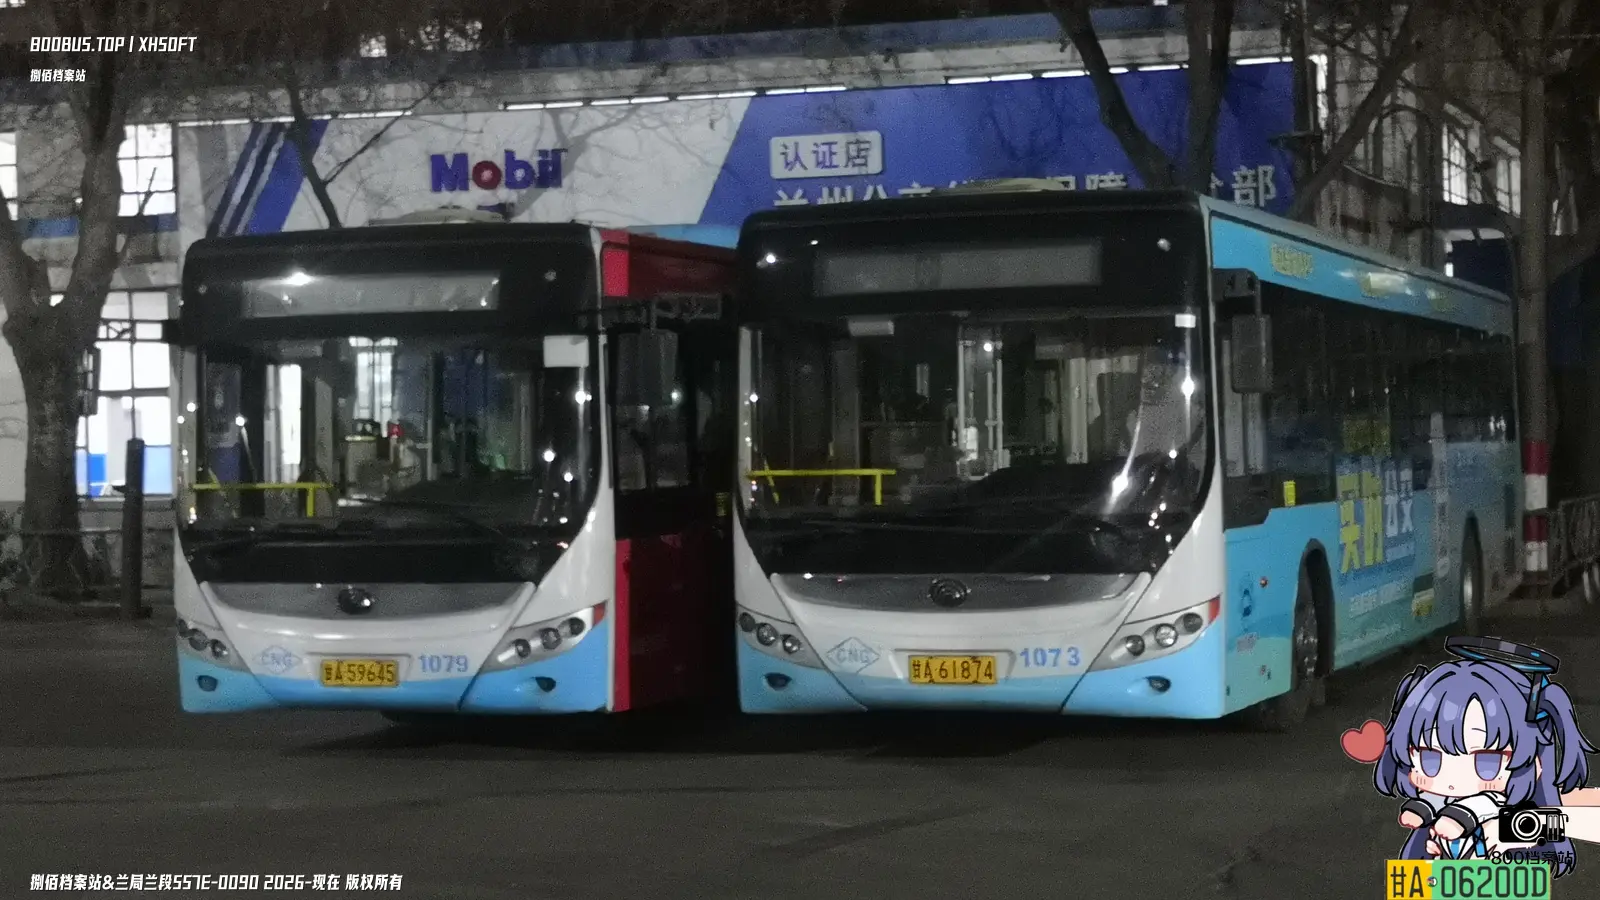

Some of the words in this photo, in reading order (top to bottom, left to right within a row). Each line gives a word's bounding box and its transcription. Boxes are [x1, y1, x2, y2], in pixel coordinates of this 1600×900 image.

[780, 139, 872, 171] 认证店
[430, 149, 565, 192] Mobil
[418, 654, 468, 673] 1079
[836, 647, 871, 664] CNG
[1019, 646, 1081, 667] 1073
